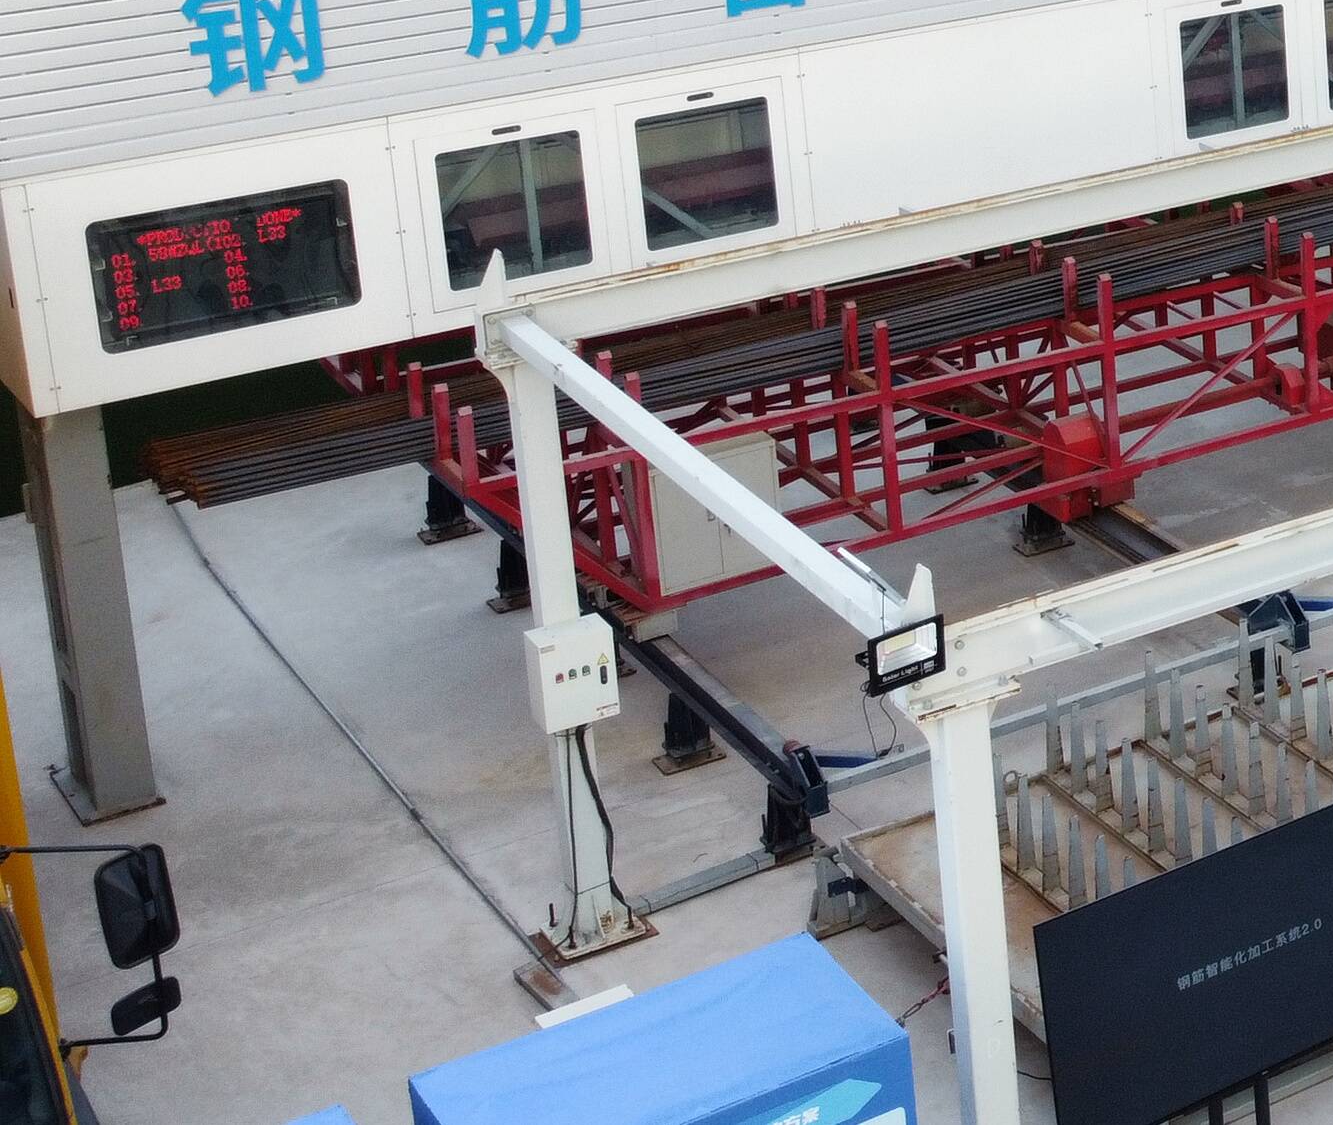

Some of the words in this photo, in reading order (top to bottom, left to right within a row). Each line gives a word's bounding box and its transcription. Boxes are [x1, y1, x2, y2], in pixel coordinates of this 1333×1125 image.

[1177, 918, 1323, 991] 钢筋智能化加工系统2.0
